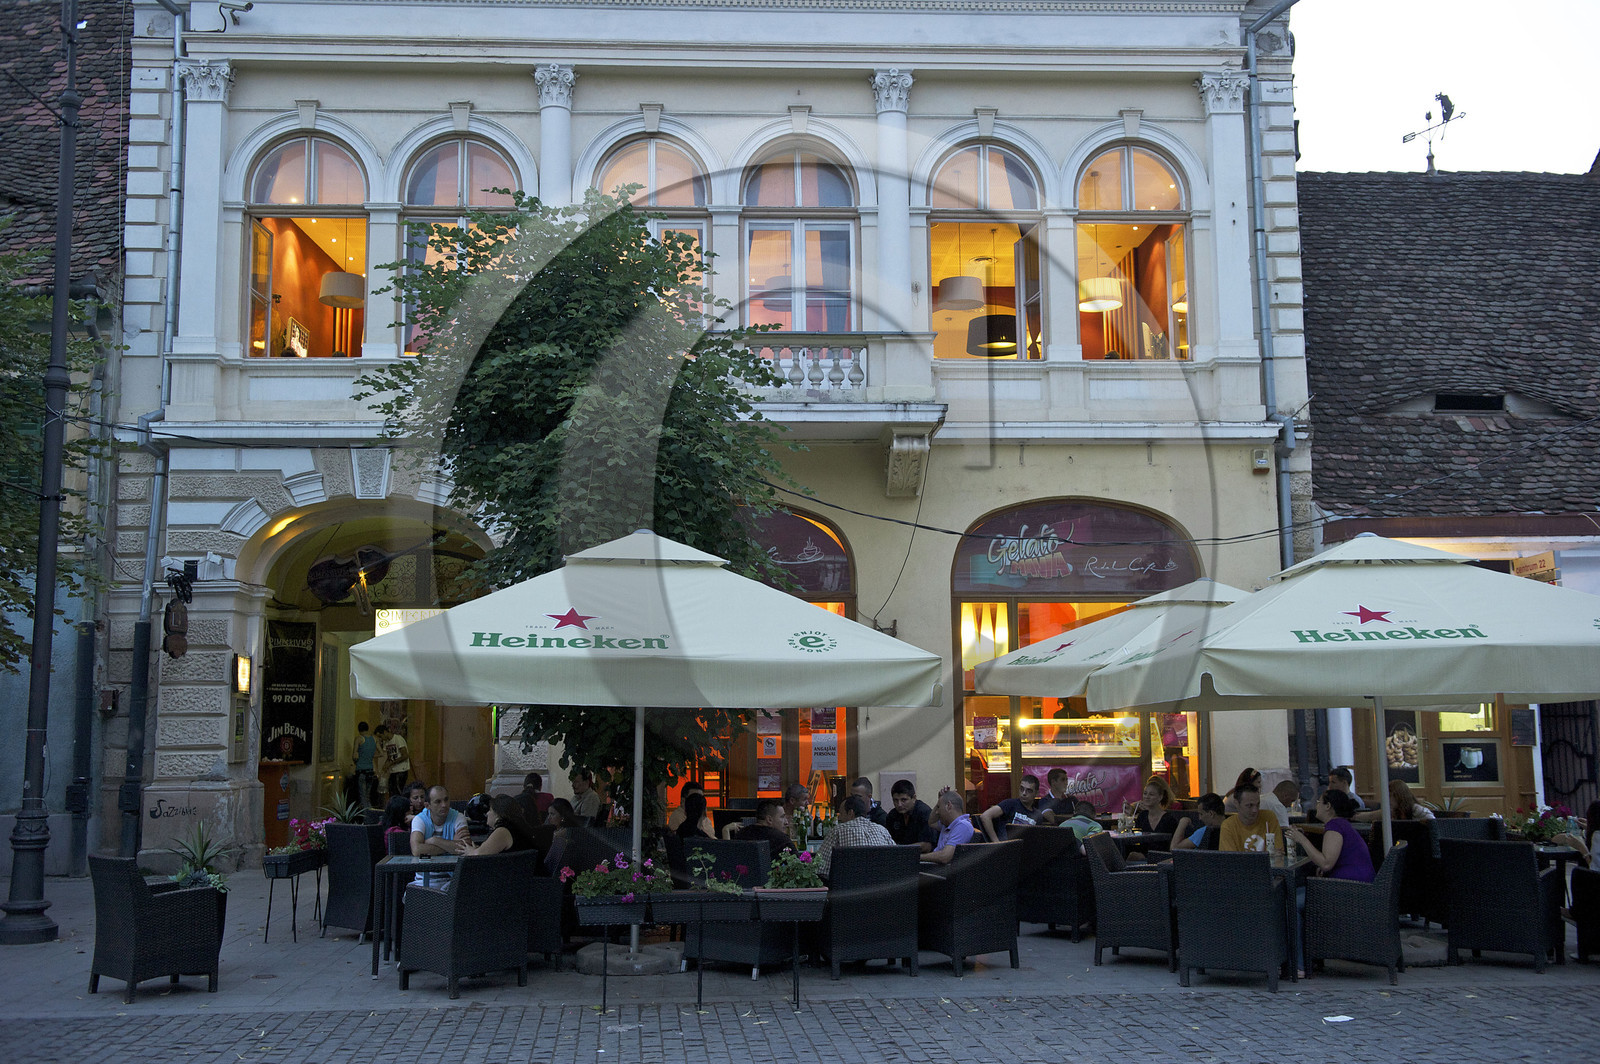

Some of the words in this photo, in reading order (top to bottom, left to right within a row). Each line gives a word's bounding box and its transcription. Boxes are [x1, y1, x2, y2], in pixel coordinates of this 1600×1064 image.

[987, 524, 1074, 576] Gelato
[1010, 551, 1071, 578] MANIA
[1516, 563, 1538, 574] centrum
[1538, 559, 1546, 569] 22
[469, 632, 669, 650] Heineken
[1290, 627, 1488, 643] Heineken
[272, 695, 282, 703] 99
[284, 695, 306, 703] RON
[268, 726, 283, 743] JIM
[284, 722, 306, 742] BEAM
[1065, 771, 1106, 794] elato
